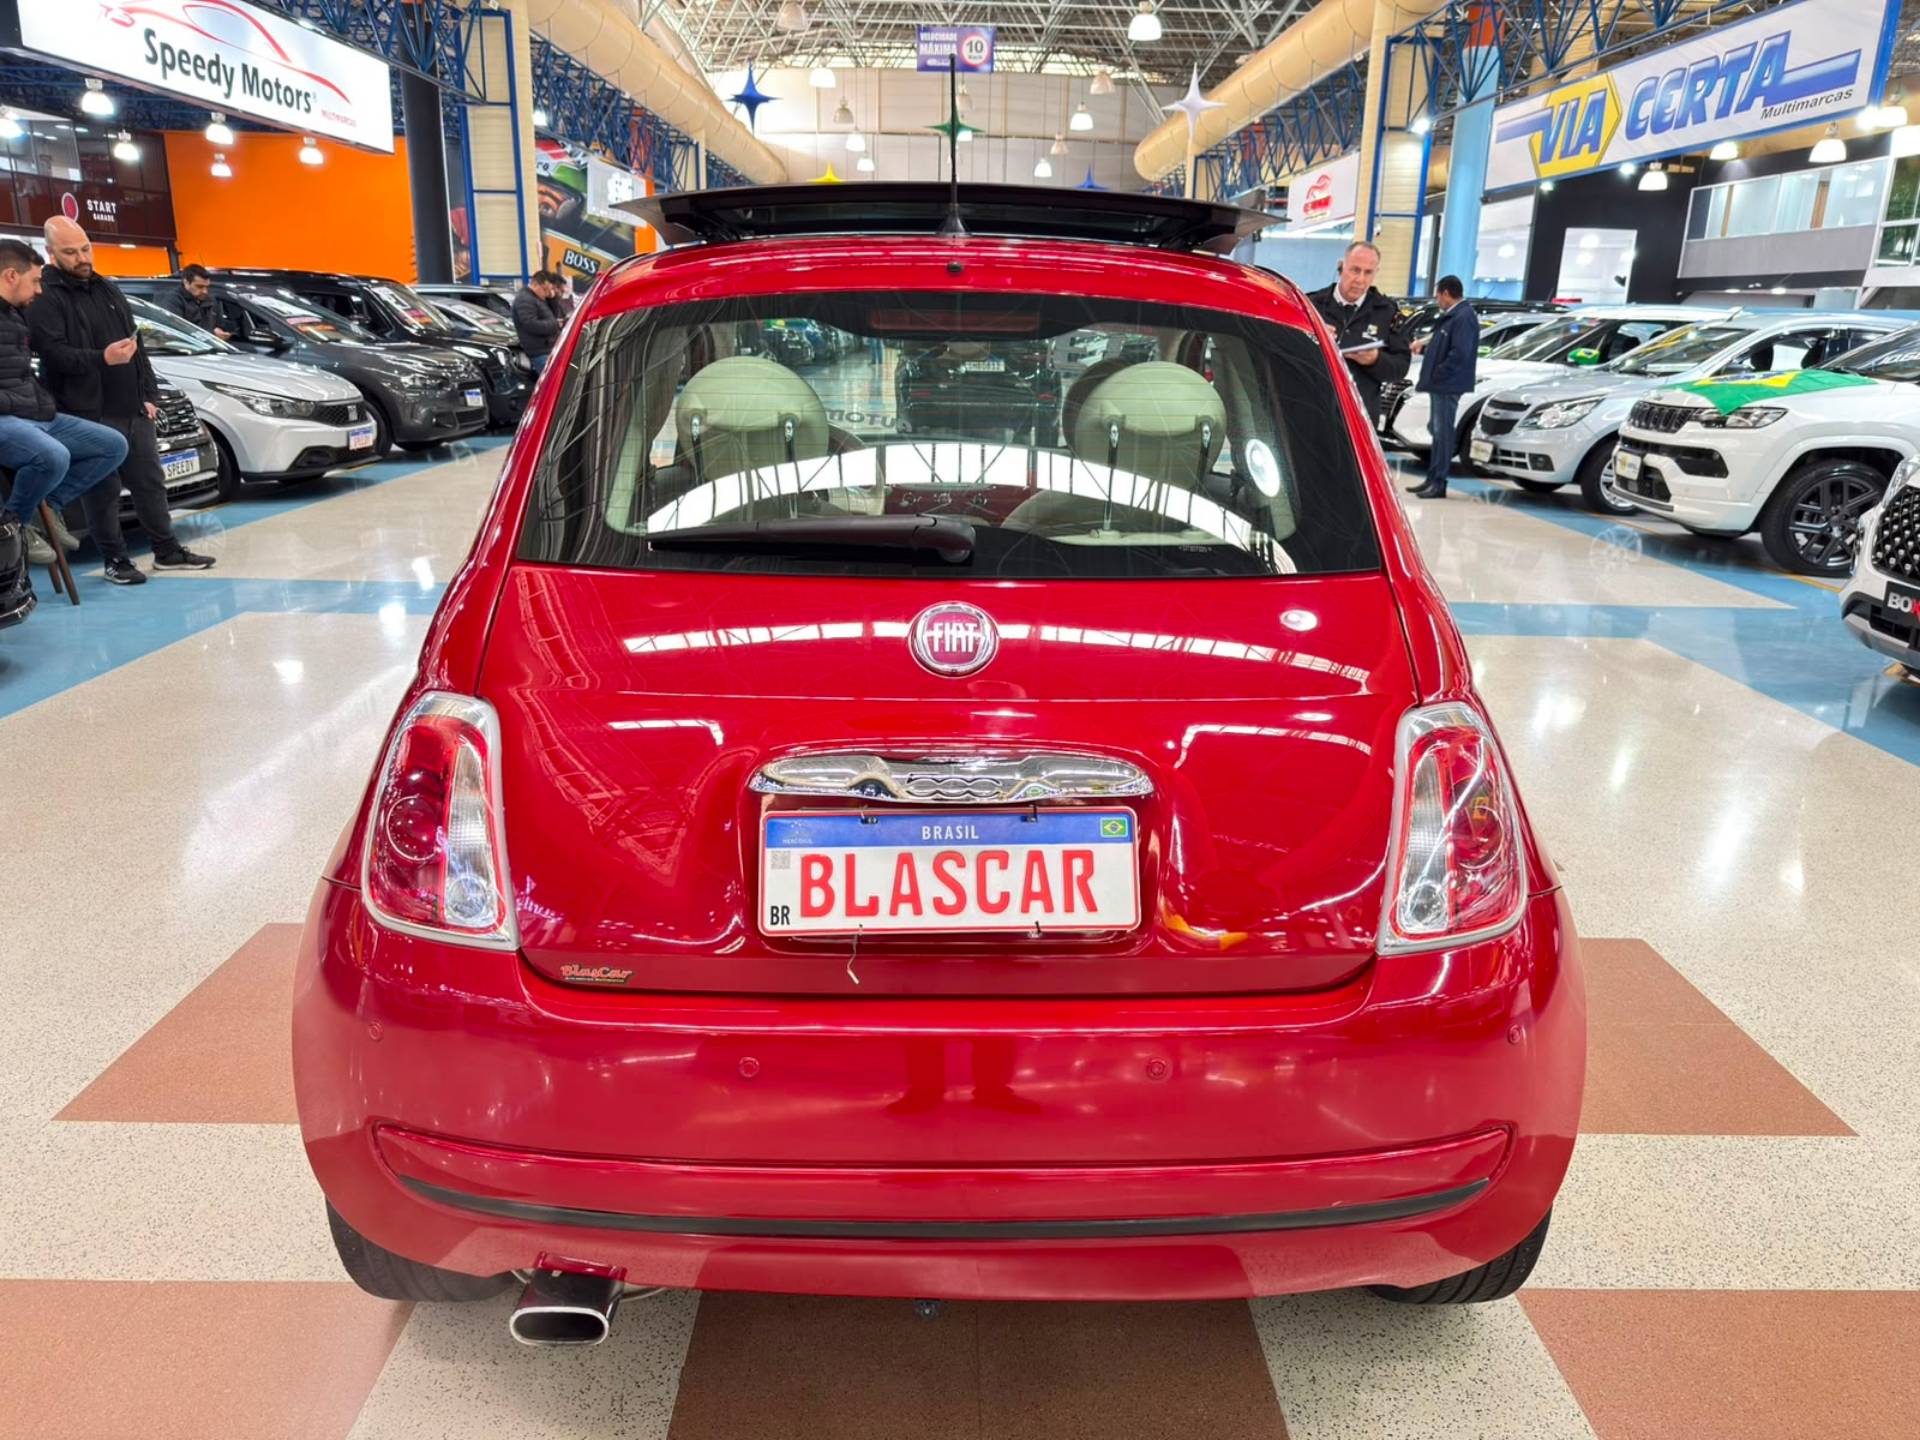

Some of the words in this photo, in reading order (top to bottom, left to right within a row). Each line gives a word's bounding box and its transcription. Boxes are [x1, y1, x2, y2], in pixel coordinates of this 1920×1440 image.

[967, 40, 984, 53] 10
[144, 28, 235, 99] Speedy
[241, 62, 312, 113] Motors
[1539, 88, 1608, 164] VIA
[1625, 30, 1792, 141] CERTA
[1760, 88, 1854, 120] Multimarcas
[87, 199, 116, 213] START
[564, 249, 597, 275] BOSS
[167, 460, 193, 477] SPEEDY
[932, 622, 978, 653] FIAT
[922, 824, 979, 841] BRASIL
[800, 850, 1099, 918] BLASCAR
[770, 905, 791, 926] BR
[560, 964, 633, 978] BlasCar
